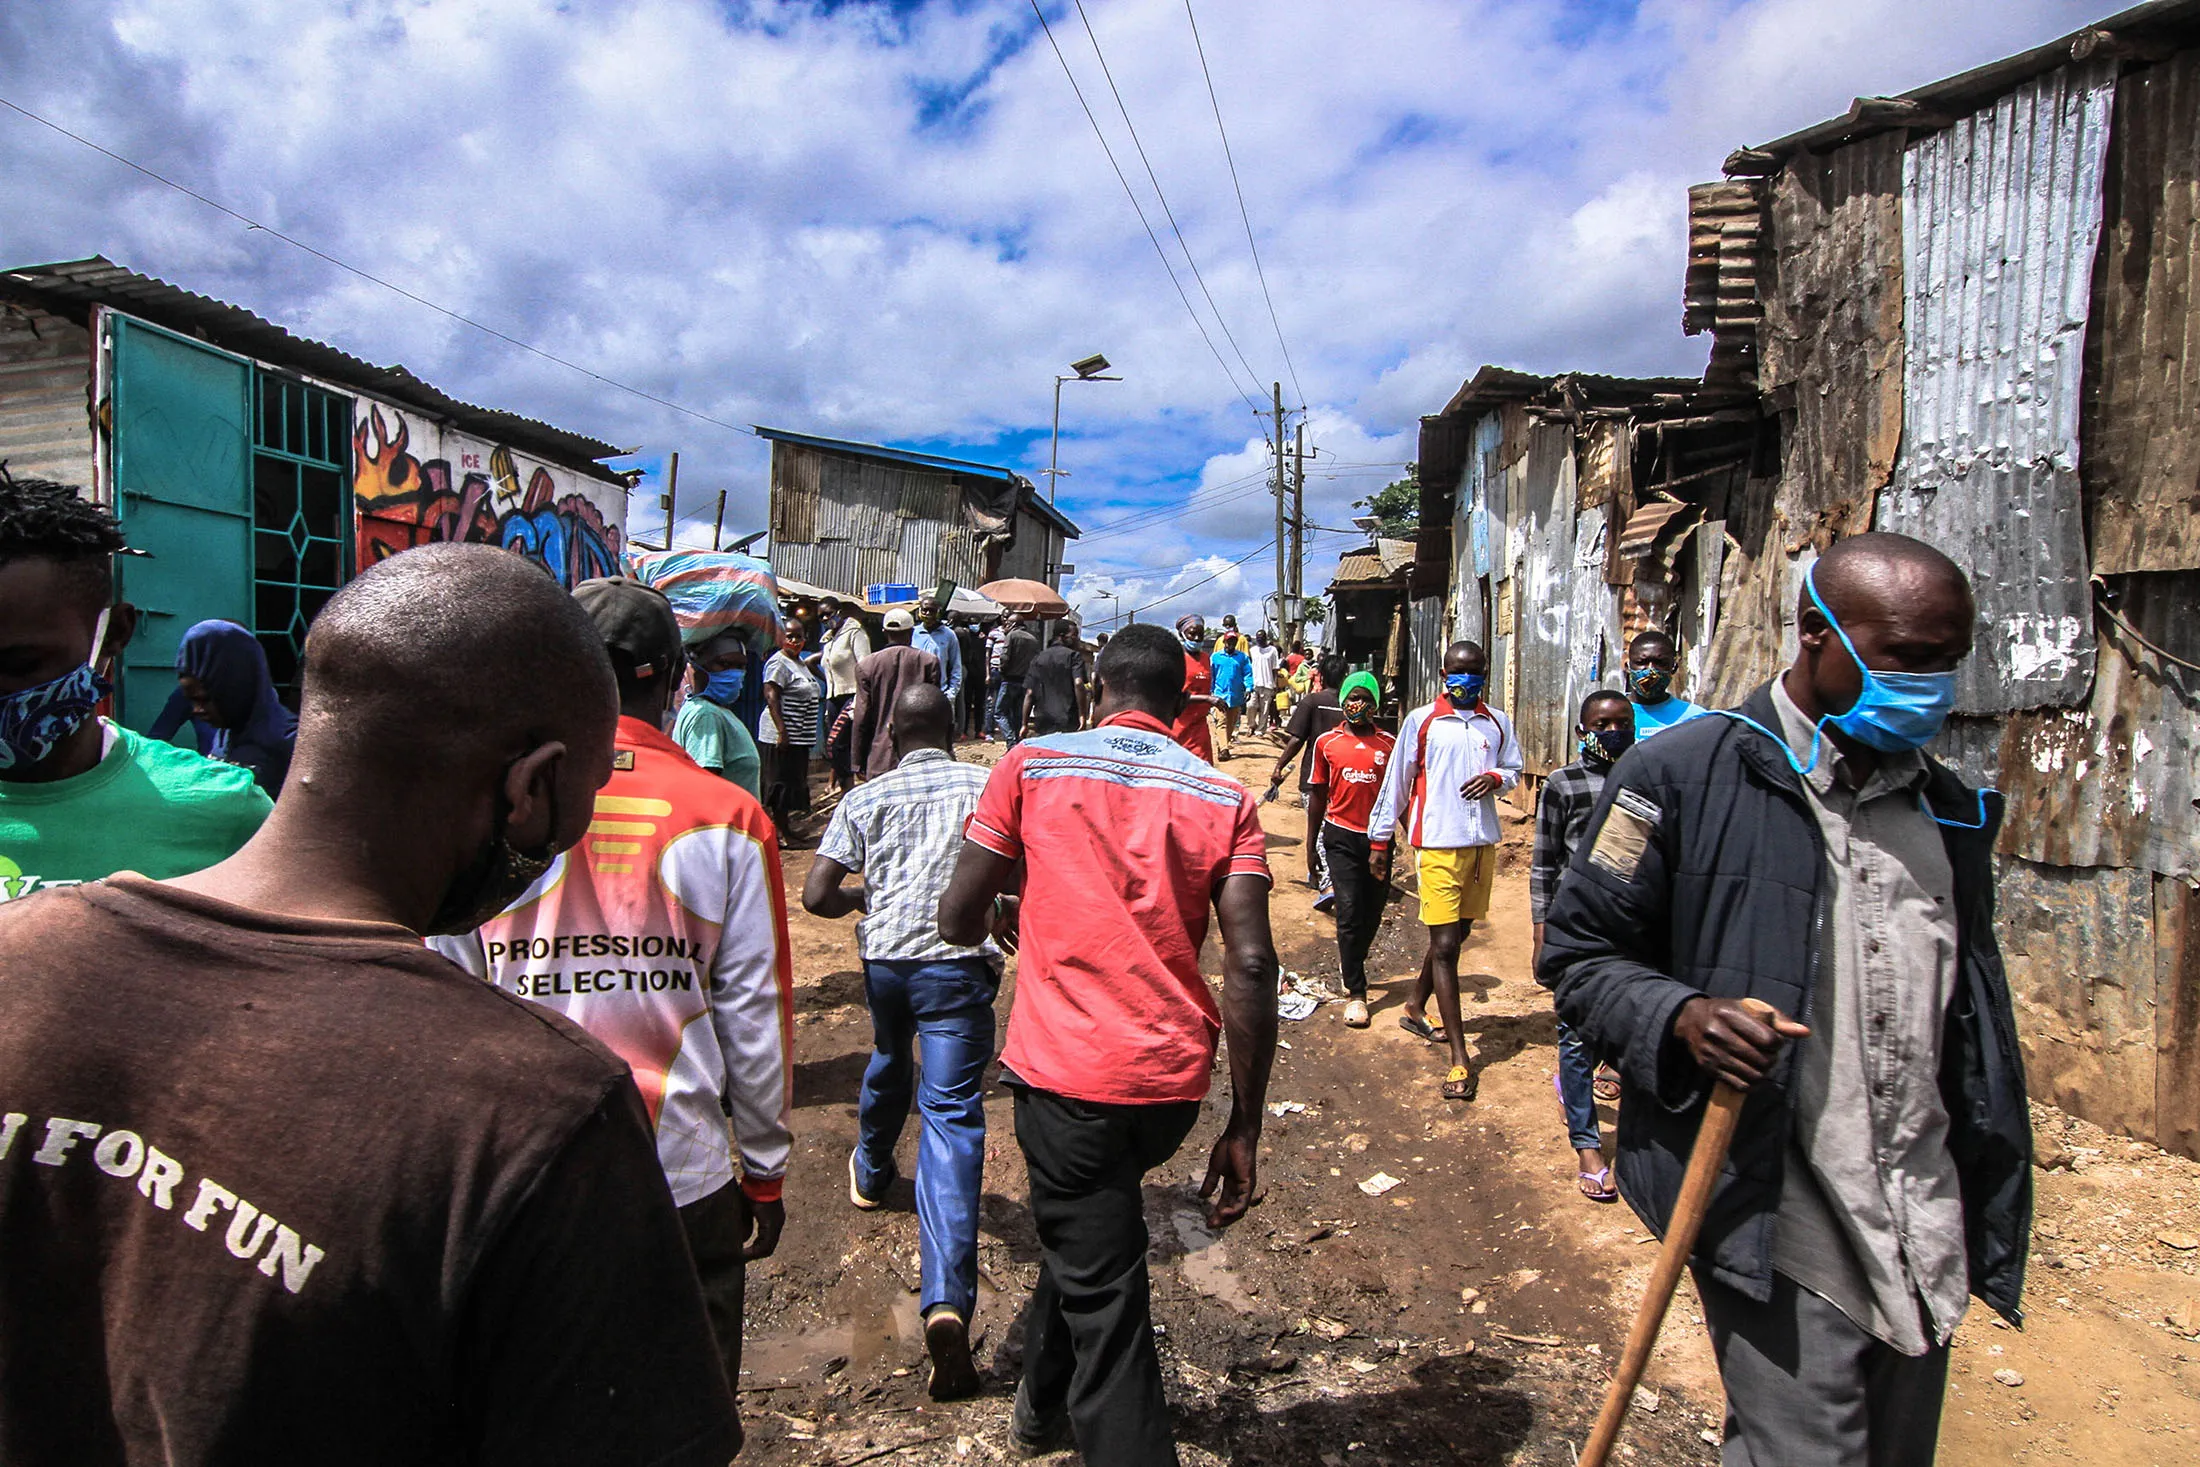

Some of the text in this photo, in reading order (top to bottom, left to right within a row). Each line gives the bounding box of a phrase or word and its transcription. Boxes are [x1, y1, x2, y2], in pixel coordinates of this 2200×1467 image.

[461, 449, 480, 469] ICE
[1342, 767, 1377, 783] Carlsberg
[517, 969, 693, 996] SELECTION
[32, 1117, 184, 1210] FOR
[183, 1177, 326, 1294] FUN
